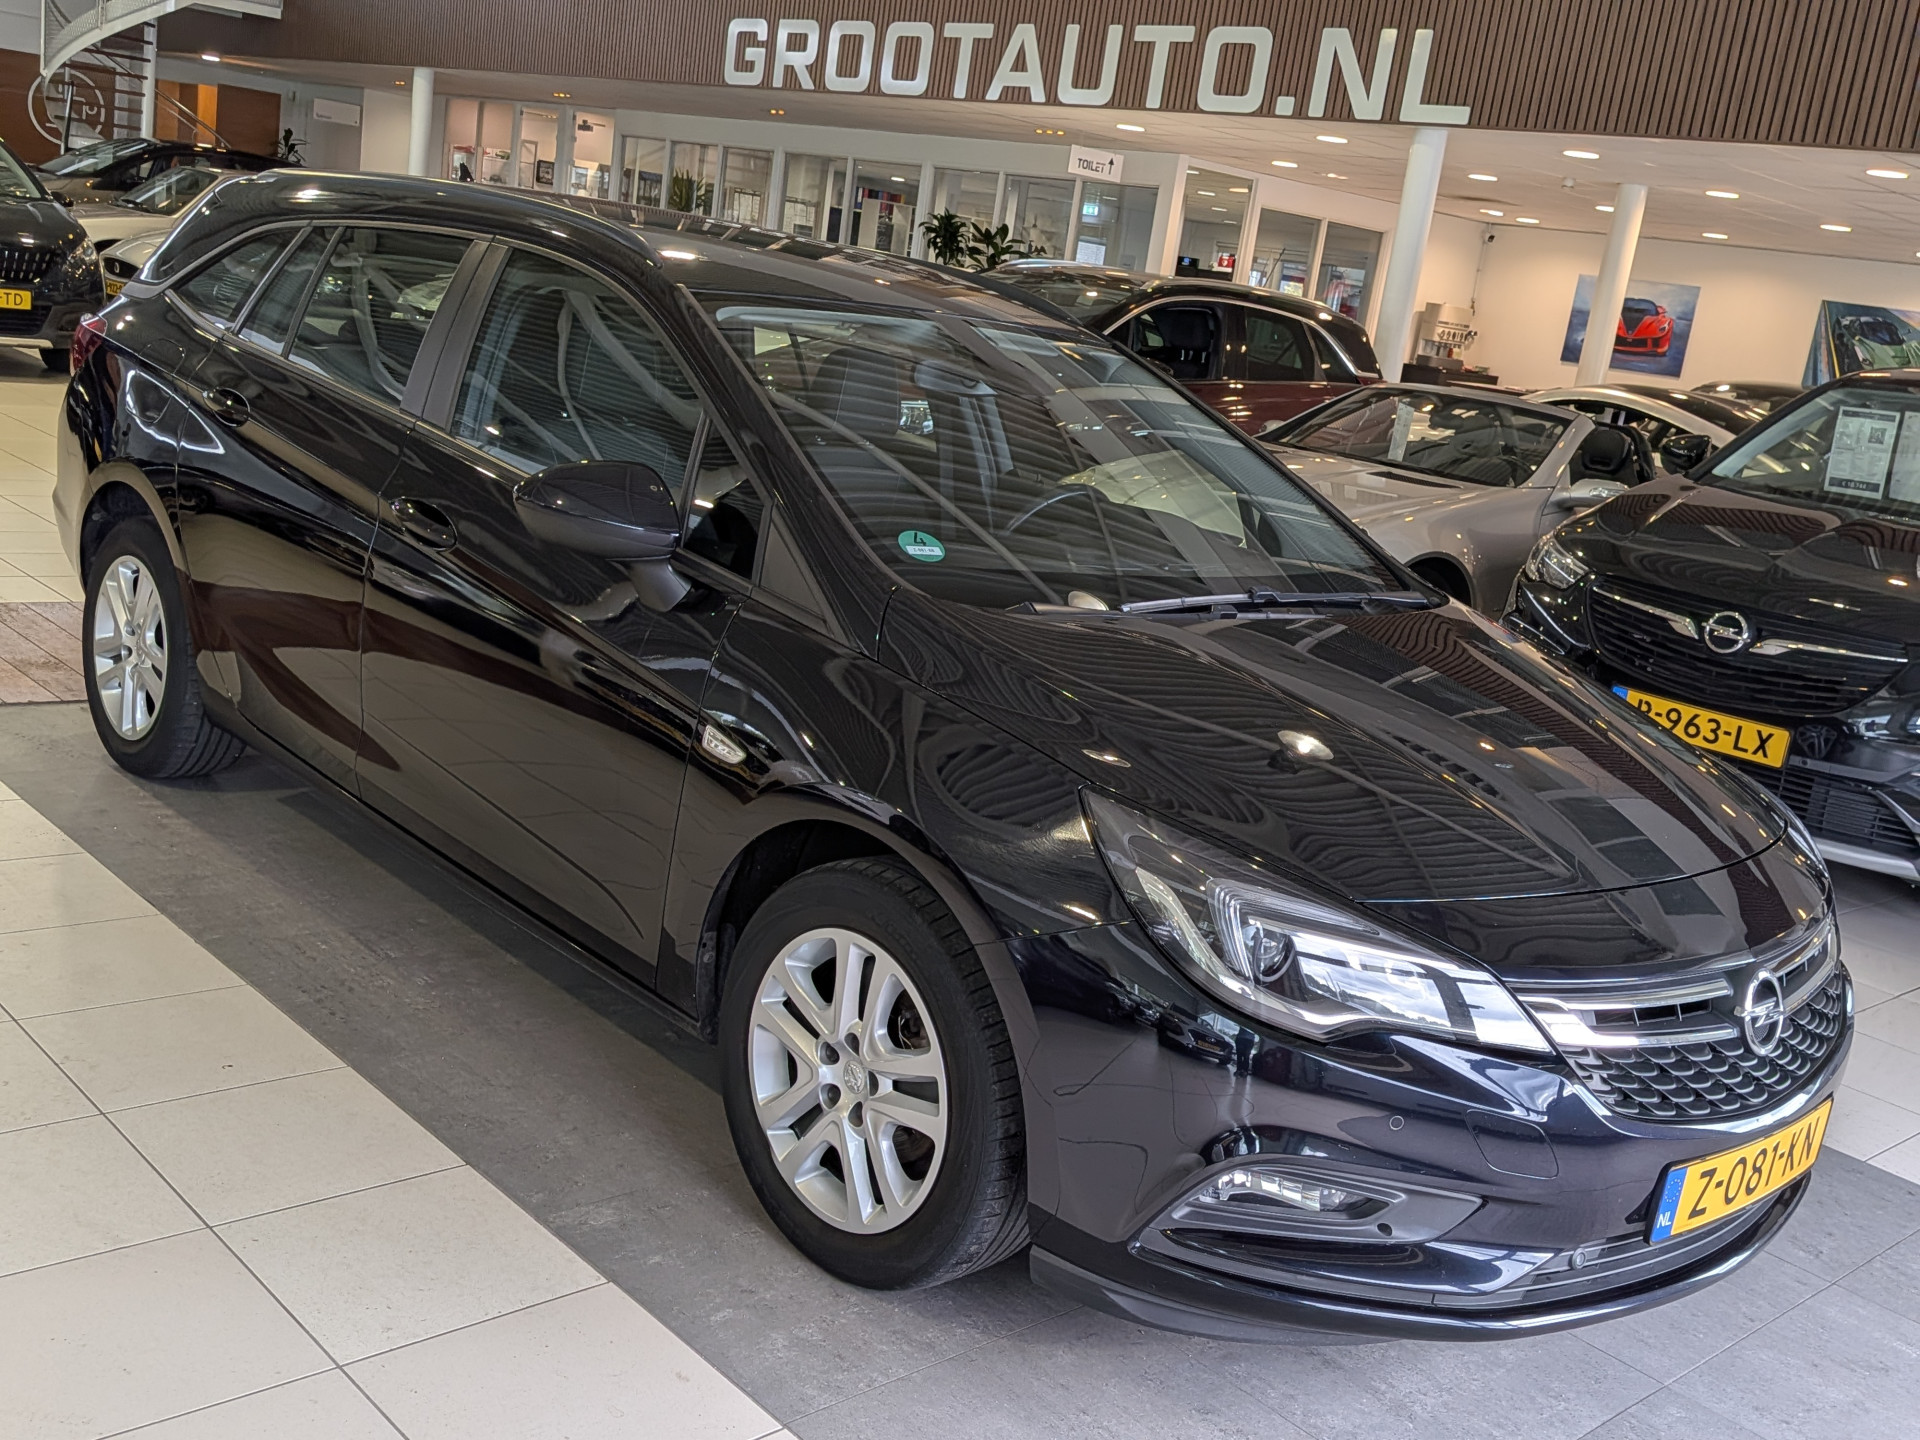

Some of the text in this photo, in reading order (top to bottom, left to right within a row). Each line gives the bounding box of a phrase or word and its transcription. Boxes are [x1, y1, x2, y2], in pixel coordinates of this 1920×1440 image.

[724, 18, 1471, 125] GROOTAUTO.NL
[1077, 157, 1107, 174] TOILET
[913, 531, 927, 546] 4
[1687, 1115, 1821, 1221] Z-081-KN
[1656, 1211, 1672, 1229] NL
